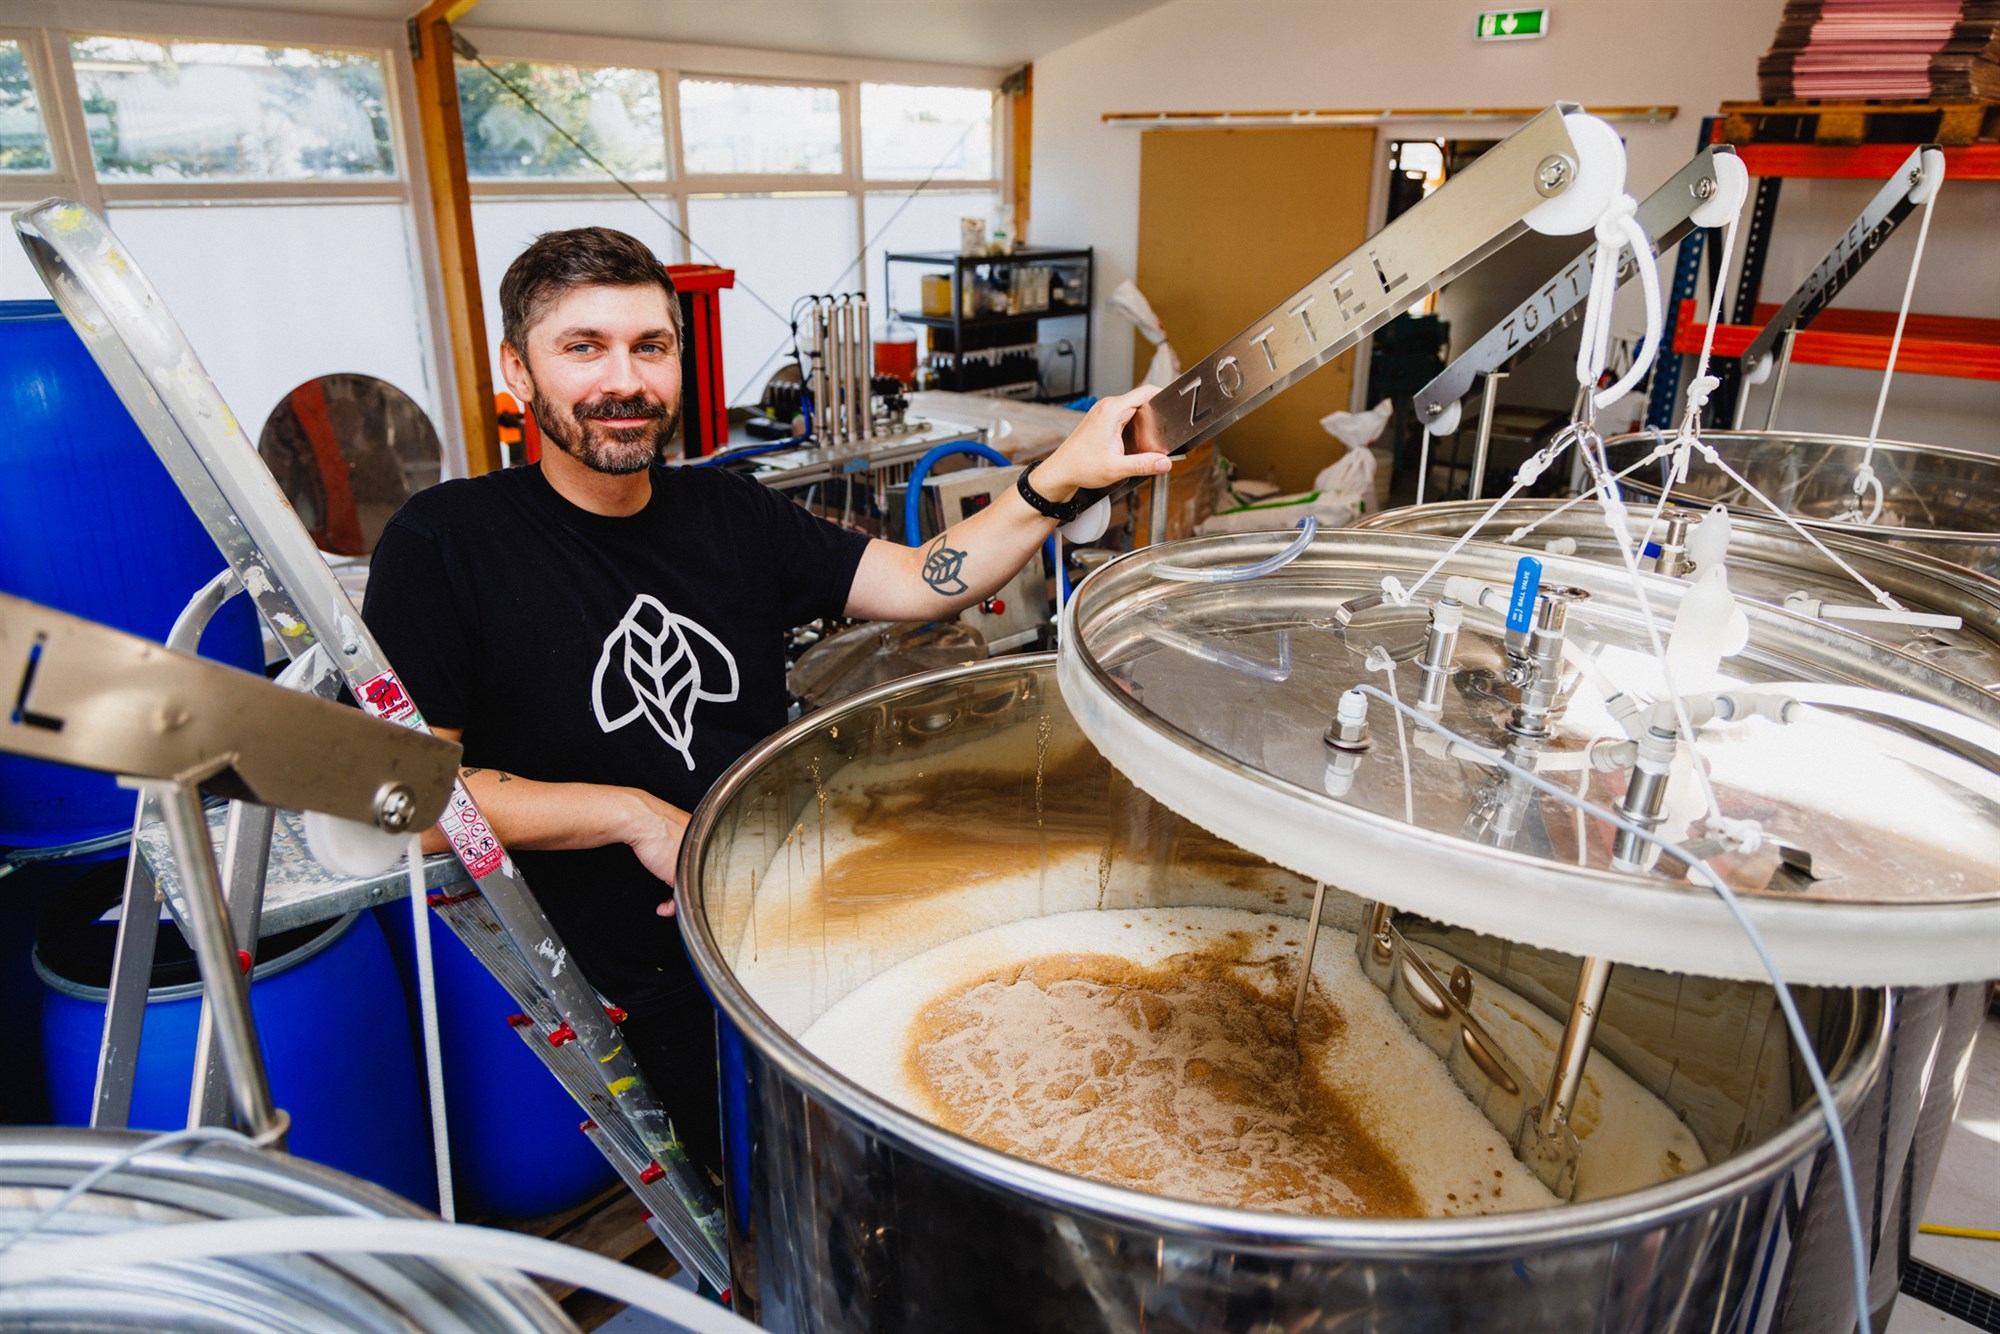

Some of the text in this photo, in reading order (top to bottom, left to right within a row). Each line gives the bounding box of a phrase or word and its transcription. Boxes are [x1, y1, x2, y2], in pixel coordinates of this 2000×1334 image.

[1179, 250, 1408, 427] ZOTTEL
[1503, 249, 1628, 351] ZOTT
[1517, 571, 1531, 607] BALL VALVE
